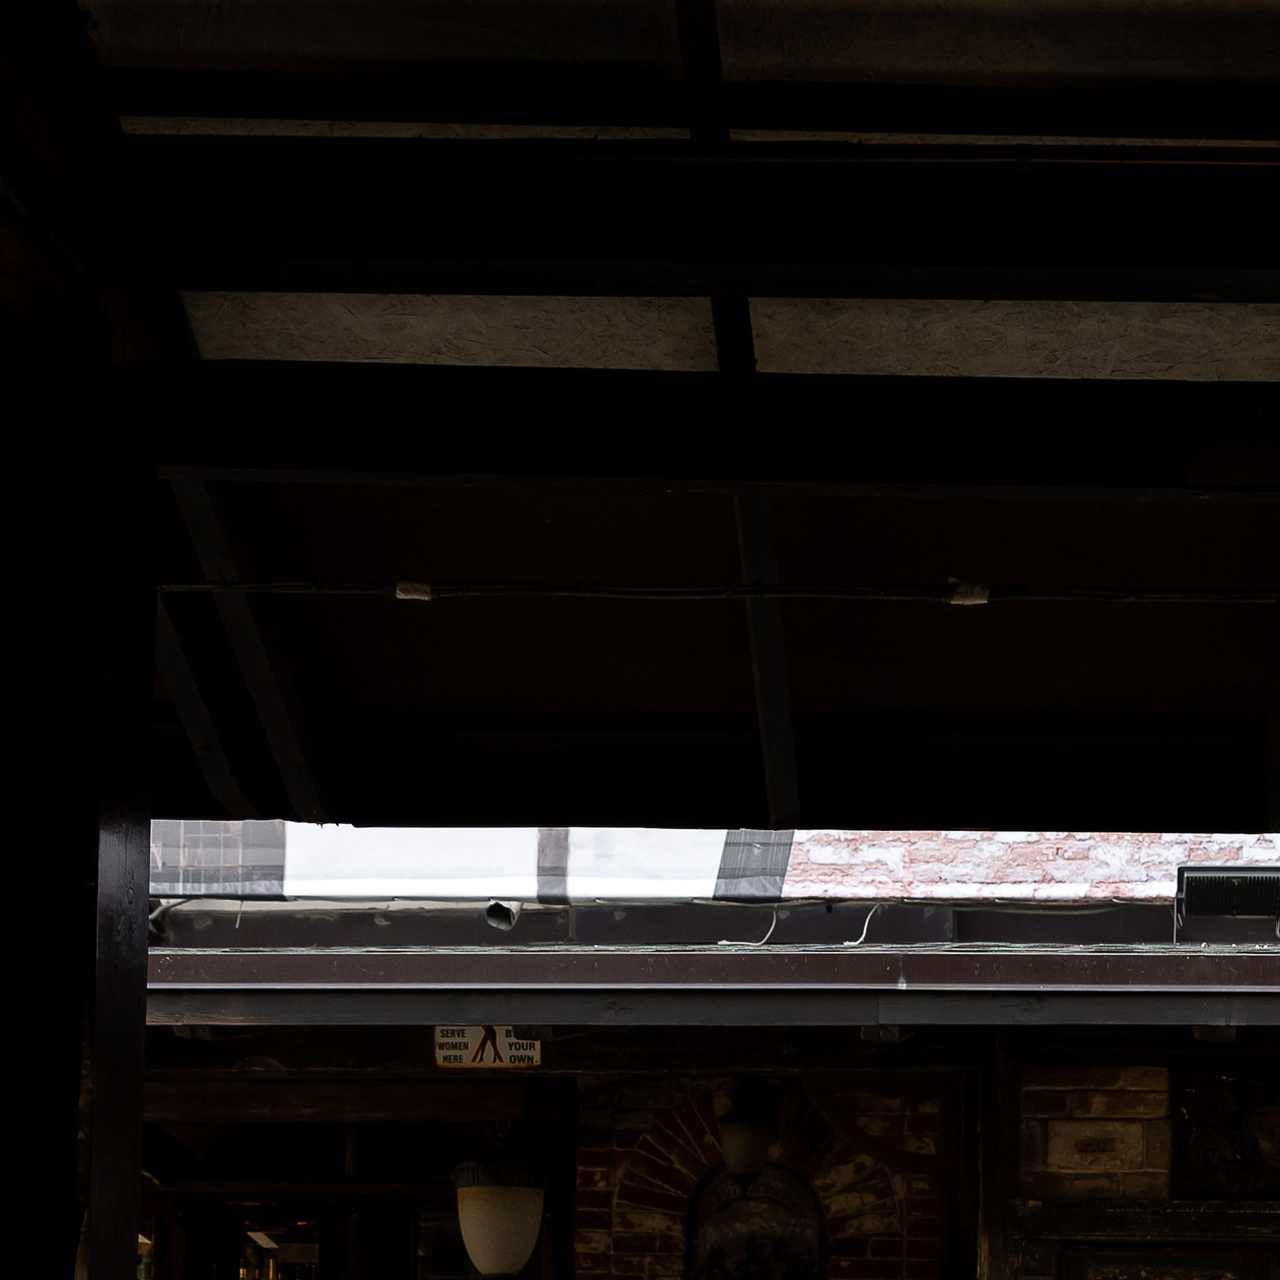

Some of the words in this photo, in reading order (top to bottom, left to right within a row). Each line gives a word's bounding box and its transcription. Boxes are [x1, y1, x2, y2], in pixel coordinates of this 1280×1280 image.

[440, 1029, 466, 1038] SERVE
[437, 1042, 469, 1051] WOMEN
[507, 1042, 536, 1051] YOUR
[442, 1055, 464, 1064] HERE
